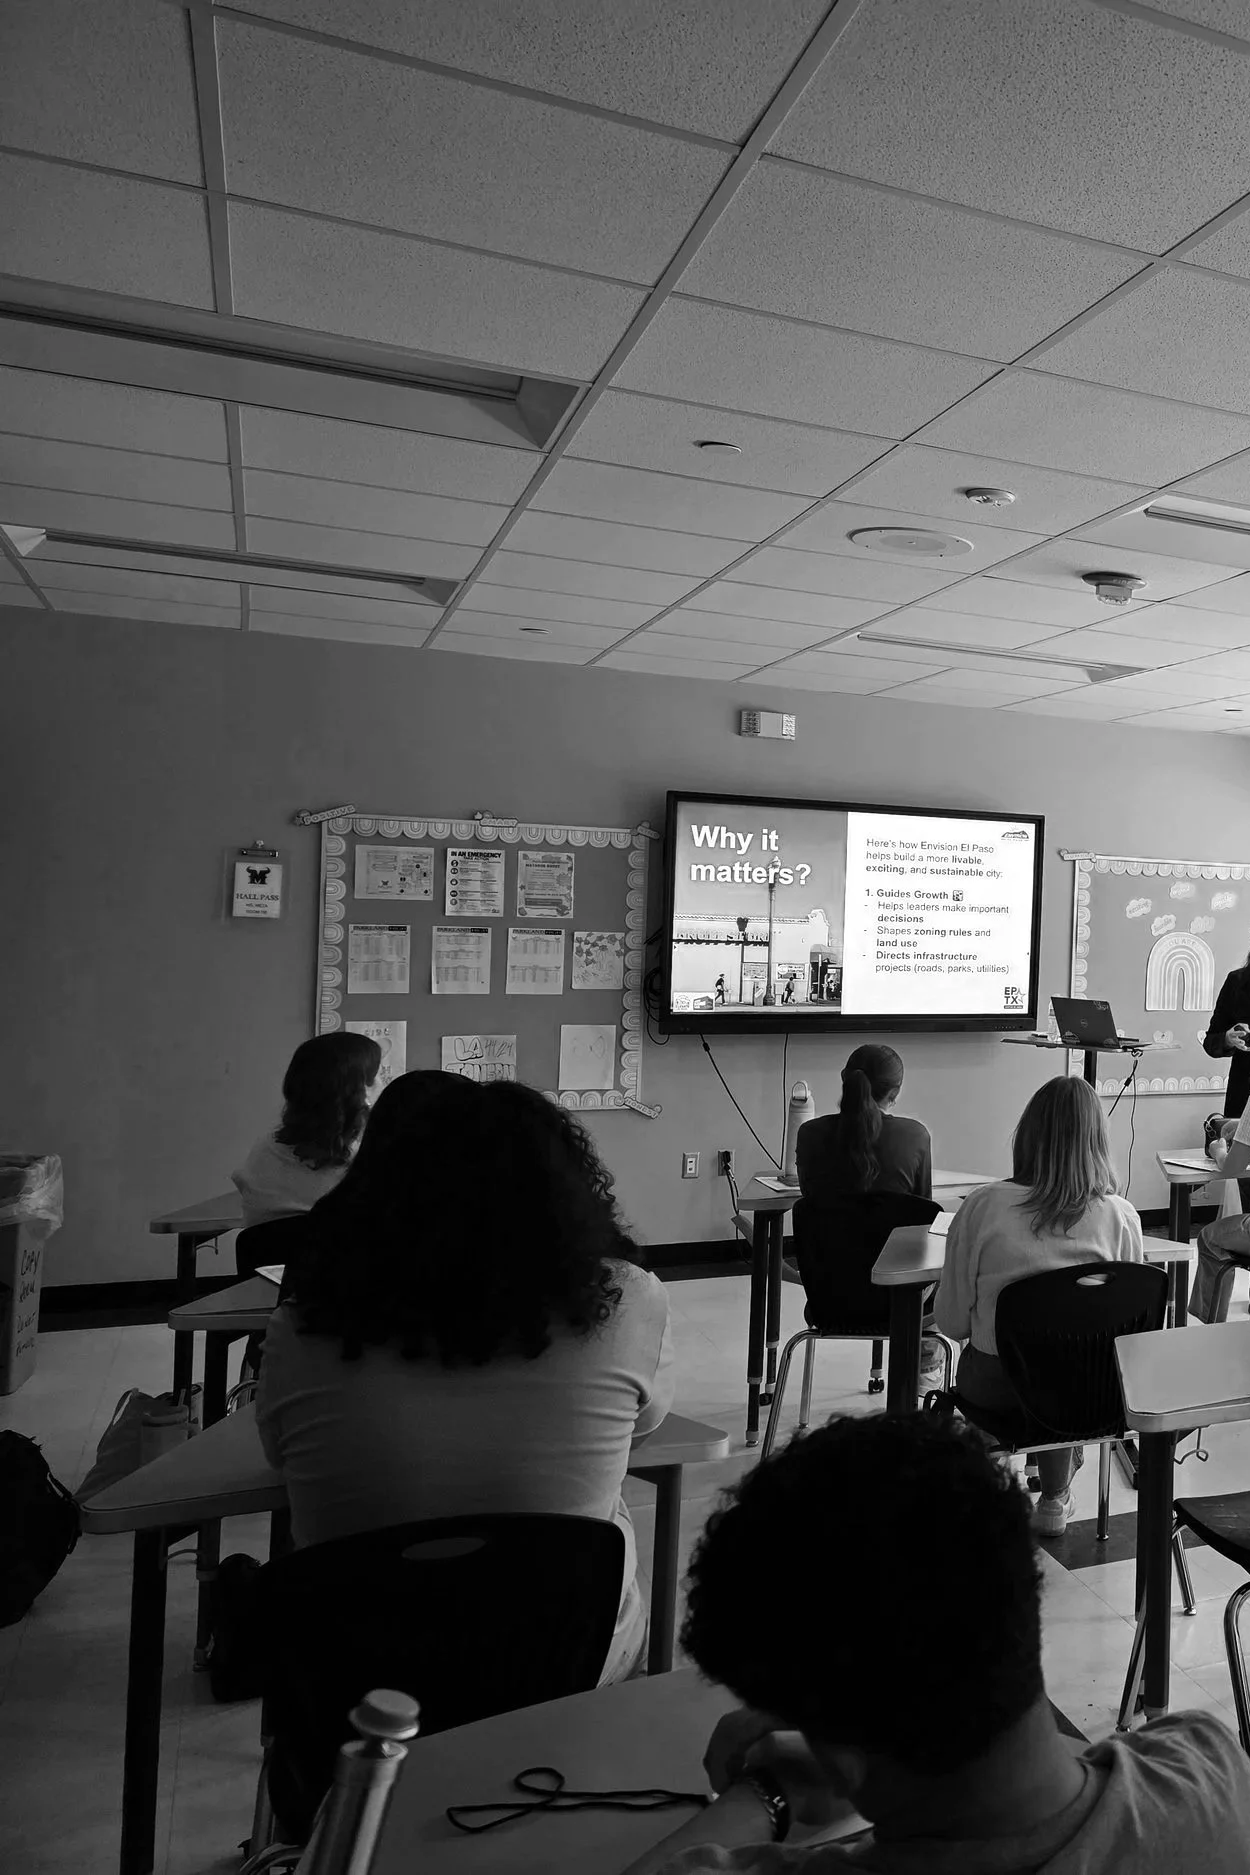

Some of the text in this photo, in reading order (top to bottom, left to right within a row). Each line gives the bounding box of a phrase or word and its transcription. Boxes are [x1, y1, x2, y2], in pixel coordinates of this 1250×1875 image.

[690, 824, 779, 855] Why it
[866, 838, 994, 853] Here's how Envision El Paso
[866, 851, 891, 861] helps
[894, 853, 915, 862] build
[690, 861, 812, 885] matters?
[866, 865, 907, 875] exciting,
[910, 866, 927, 874] and
[930, 867, 984, 877] sustainable
[865, 889, 949, 900] 1. Guides Growth
[878, 901, 1009, 915] Helps leaders make important
[877, 913, 924, 923] decisions
[877, 926, 991, 937] Shapes zoning rules and
[876, 939, 898, 947] land
[876, 951, 978, 961] Directs infrastructure
[875, 964, 1010, 974] projects (roads, parks, utilities)
[1004, 987, 1017, 996] EP
[1004, 996, 1019, 1004] TX
[626, 1099, 657, 1117] HONEST
